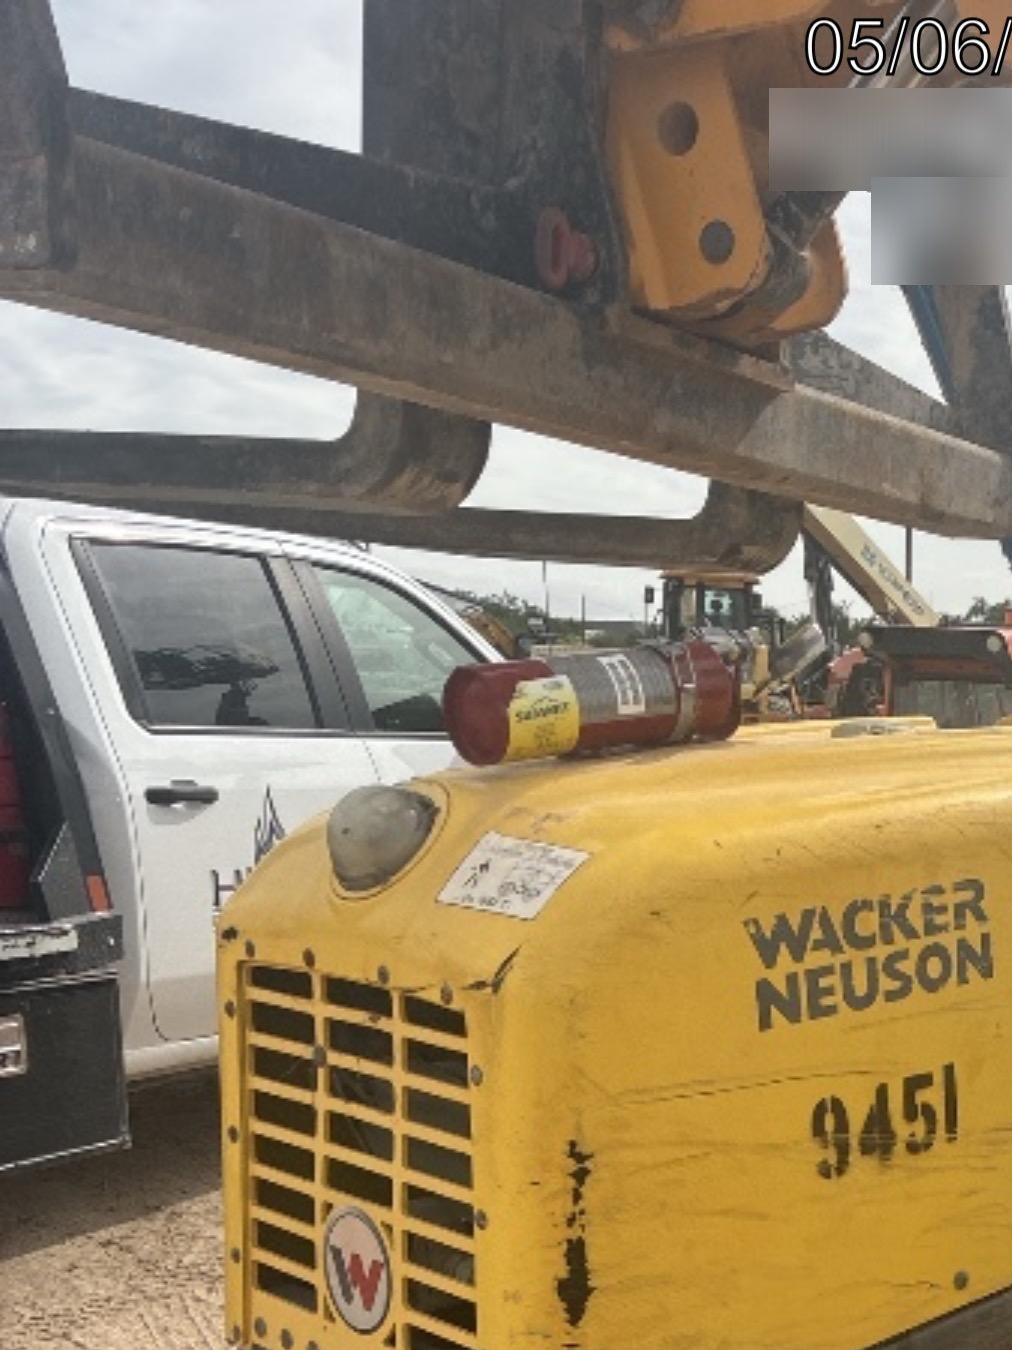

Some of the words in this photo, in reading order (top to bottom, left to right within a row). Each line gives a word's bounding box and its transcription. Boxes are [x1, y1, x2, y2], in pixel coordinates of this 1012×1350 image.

[743, 878, 989, 970] WACKER
[755, 932, 994, 1032] NEUSON
[811, 1062, 958, 1180] 9451
